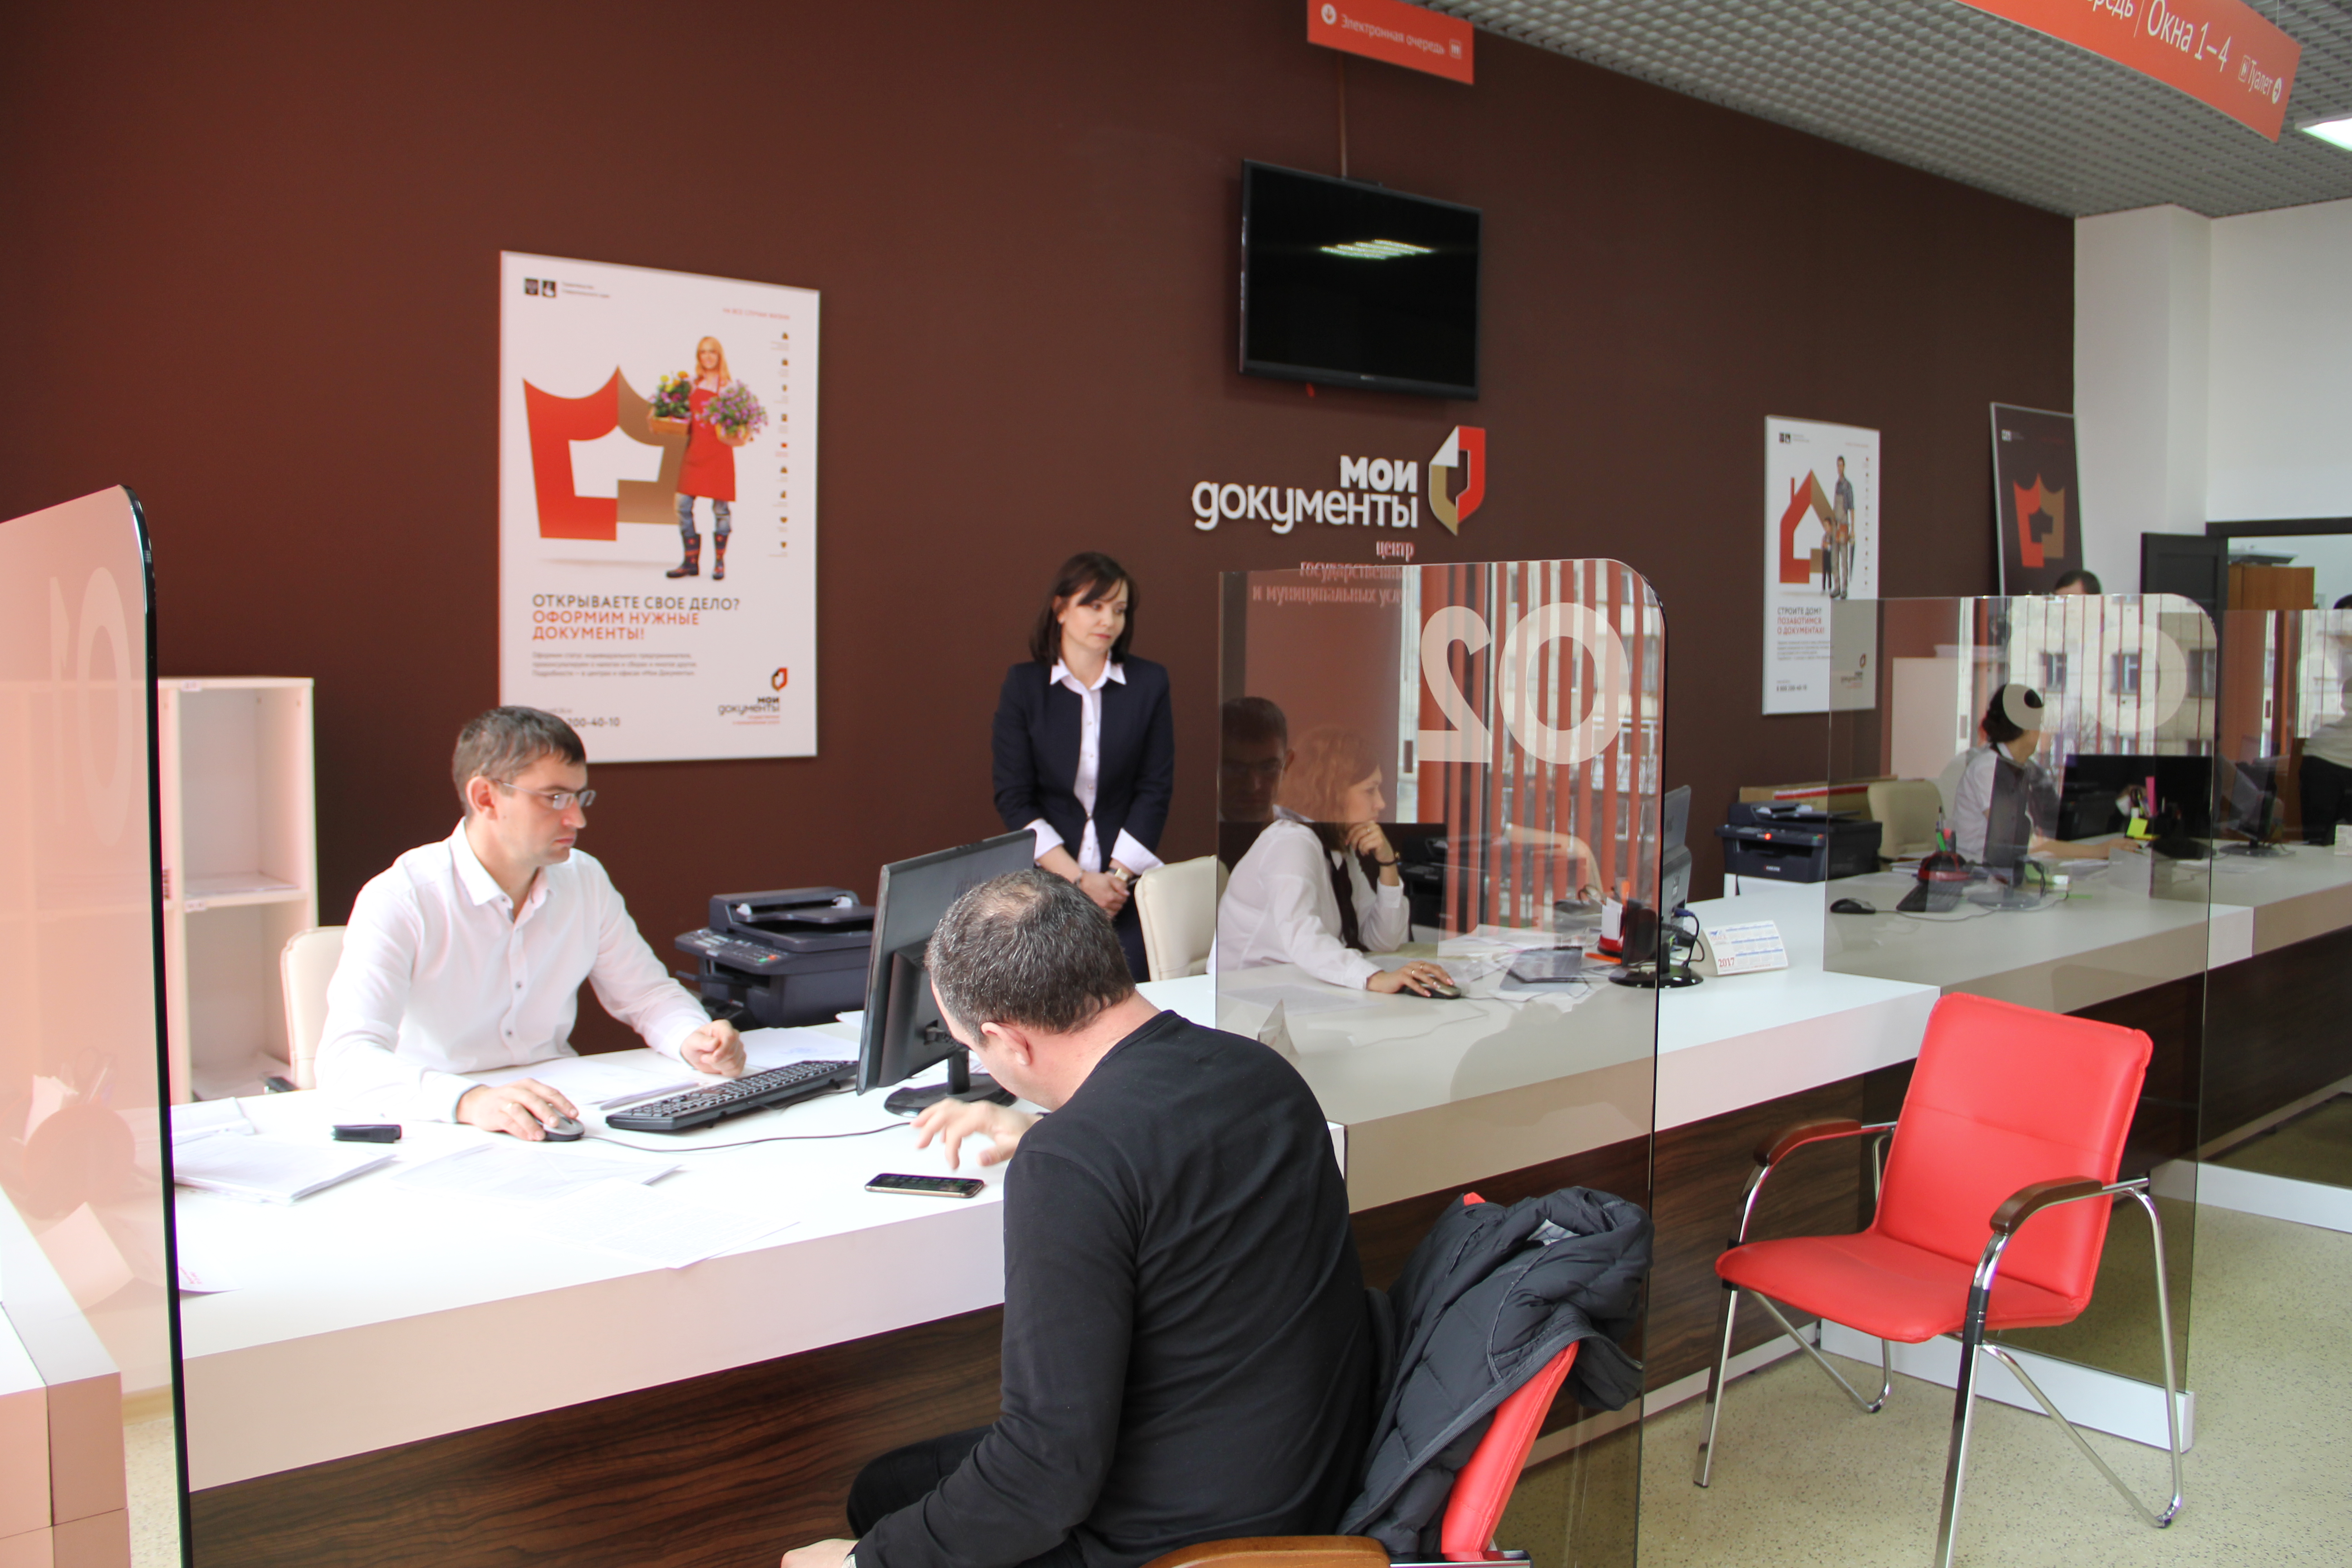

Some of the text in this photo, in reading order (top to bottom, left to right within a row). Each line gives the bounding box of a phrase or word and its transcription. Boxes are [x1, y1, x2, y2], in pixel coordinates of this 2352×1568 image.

[1341, 14, 1445, 55] Электронная очередь
[2147, 0, 2193, 53] Окна
[2248, 59, 2273, 96] Туалет
[1191, 480, 1418, 534] документы
[1376, 541, 1415, 562] центр
[532, 594, 740, 611] ОТКРЫВАЕТЕ СВОЕ ДЕЛО?
[532, 611, 700, 626] ОФОРМИМ НУЖНЫЕ
[1777, 607, 1821, 616] СТРОИТЕ ДОМ?
[1777, 617, 1821, 625] ПОЗАБОТИМСЯ
[532, 626, 645, 641] ДОКУМЕНТЫ!
[1777, 626, 1824, 635] О ДОКУМЕНТАХ!
[1718, 957, 1735, 967] 2017
